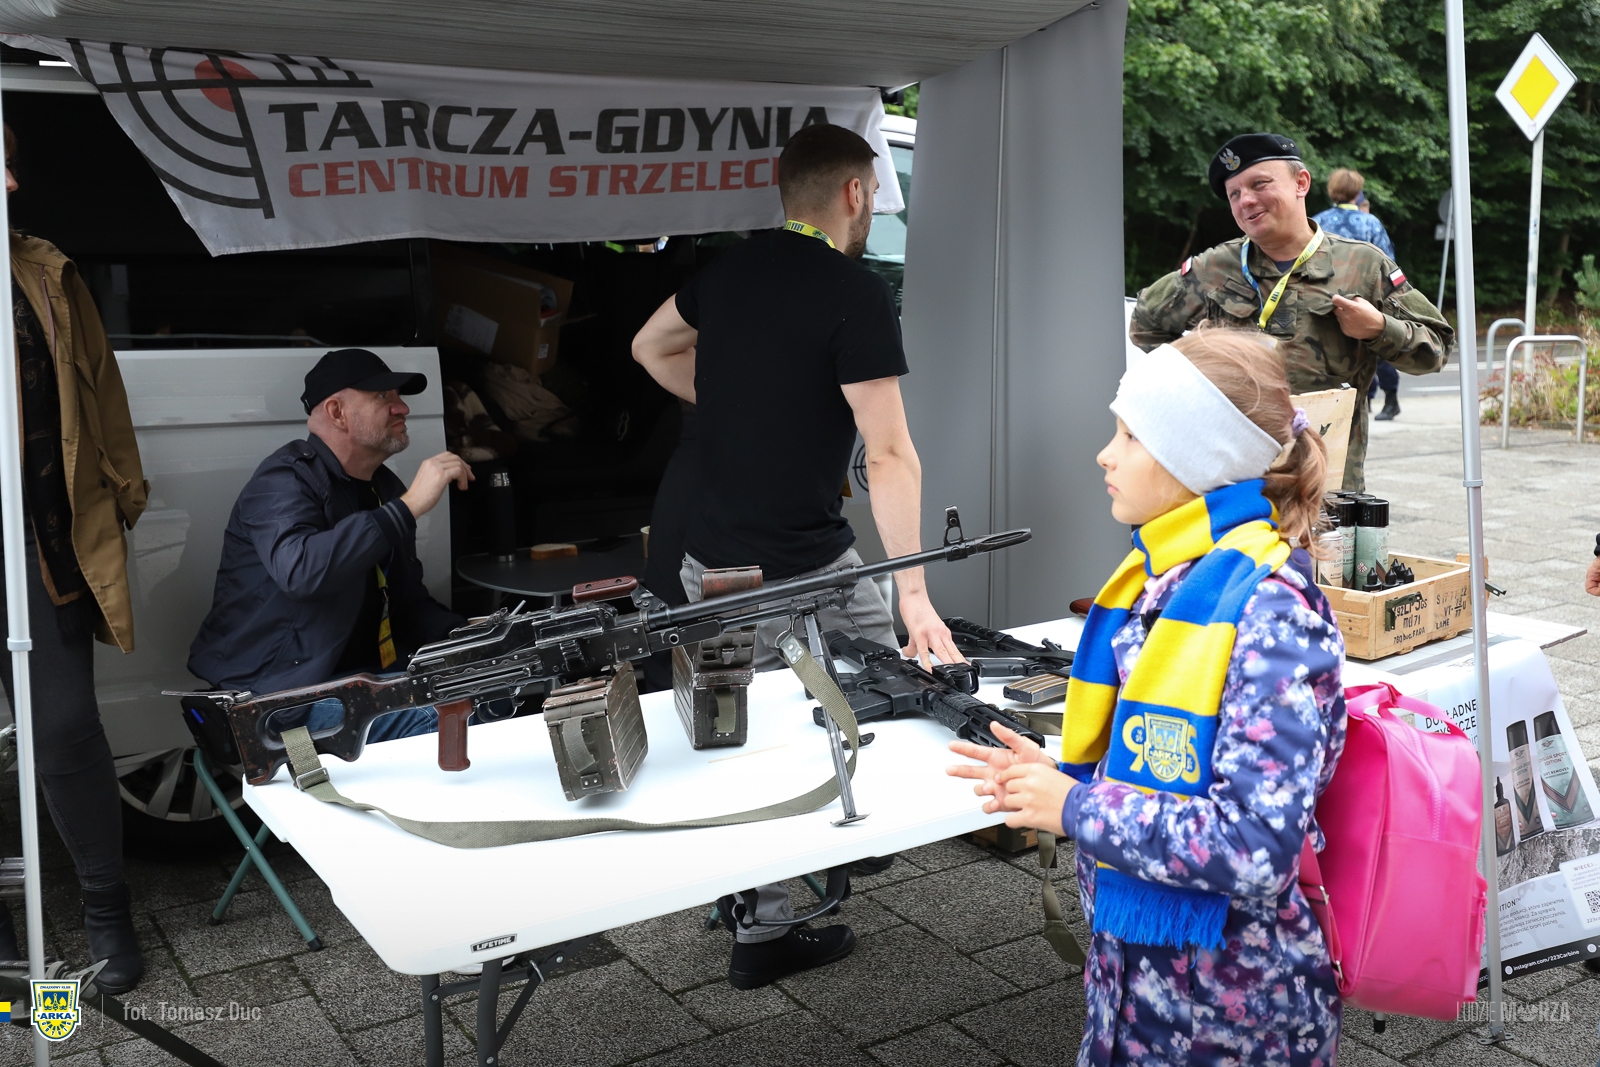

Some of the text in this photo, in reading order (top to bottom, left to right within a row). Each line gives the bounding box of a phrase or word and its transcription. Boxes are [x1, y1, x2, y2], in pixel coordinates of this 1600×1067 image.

[288, 157, 779, 198] CENTRUM STRZELEC
[476, 936, 512, 951] LIFETIME
